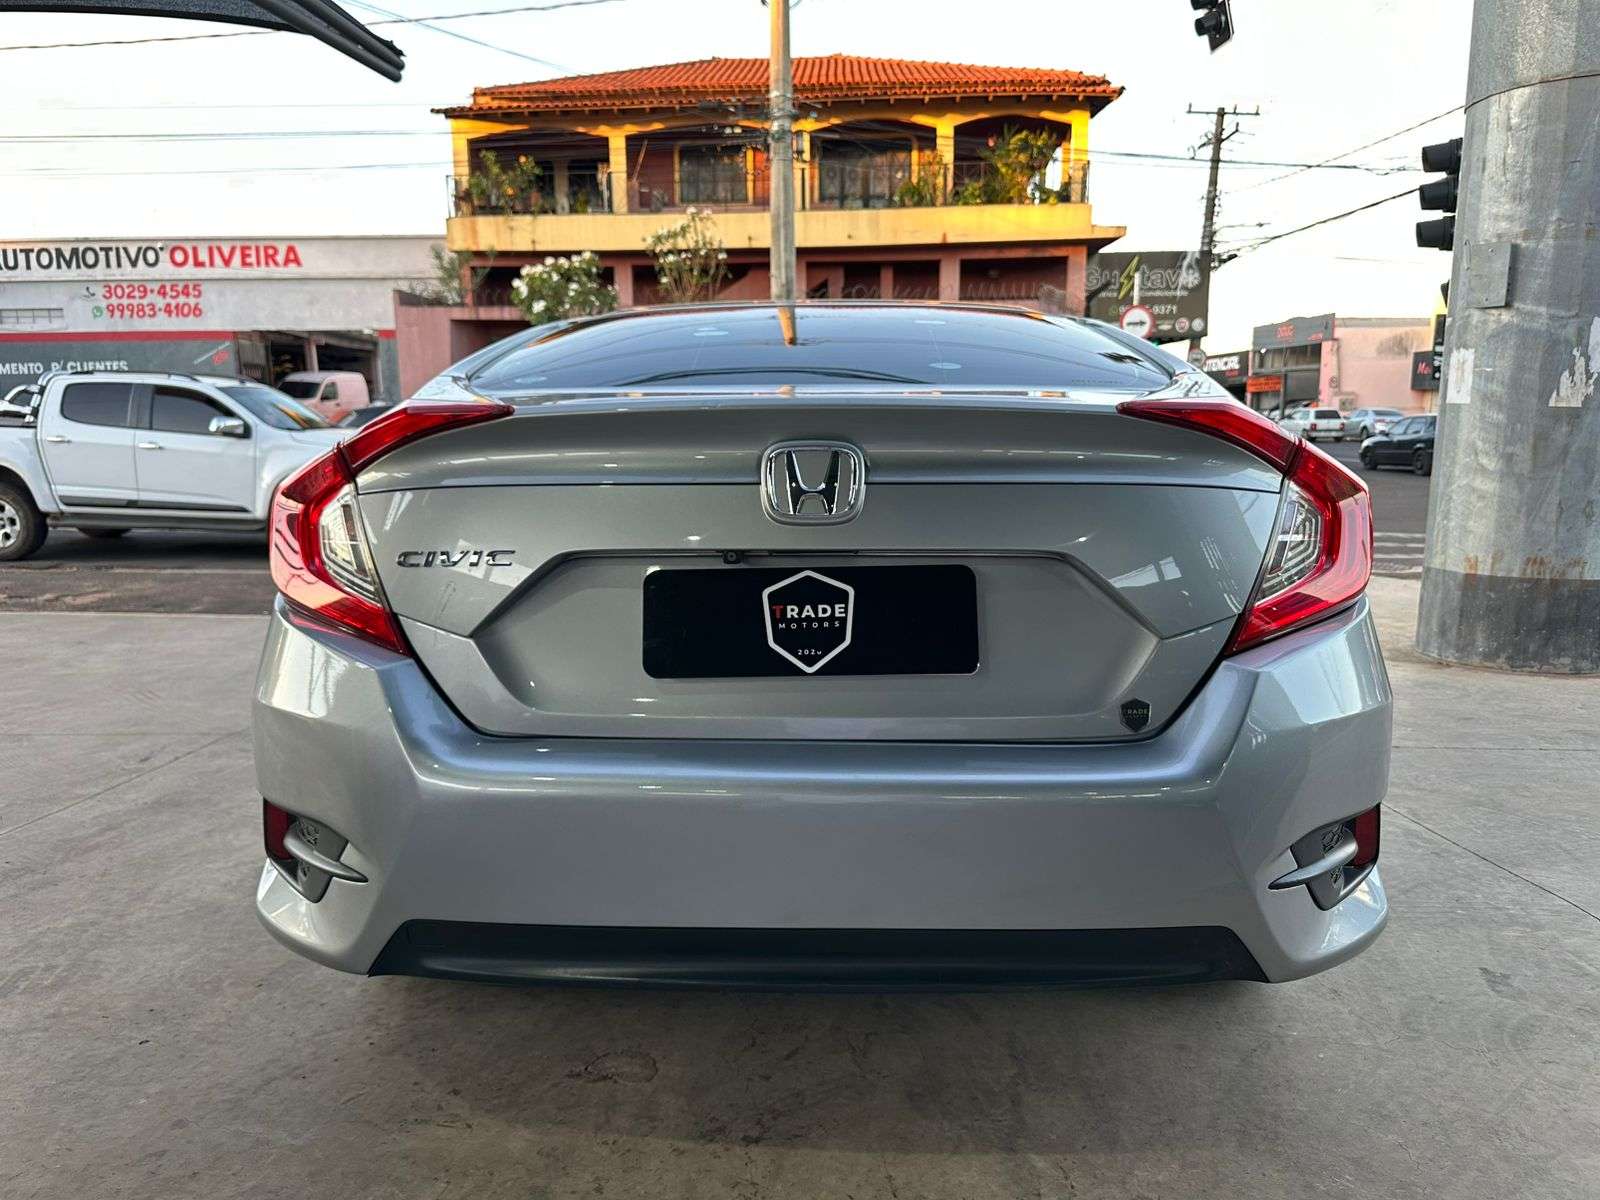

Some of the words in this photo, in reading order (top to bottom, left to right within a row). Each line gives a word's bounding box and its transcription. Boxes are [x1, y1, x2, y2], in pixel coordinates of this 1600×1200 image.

[0, 245, 160, 271] UTOMOTIVO
[169, 244, 302, 268] OLIVEIRA
[66, 360, 128, 372] CLIENTES
[396, 549, 516, 568] CIVIC
[772, 603, 846, 619] TRADE
[779, 620, 840, 629] MOTORS
